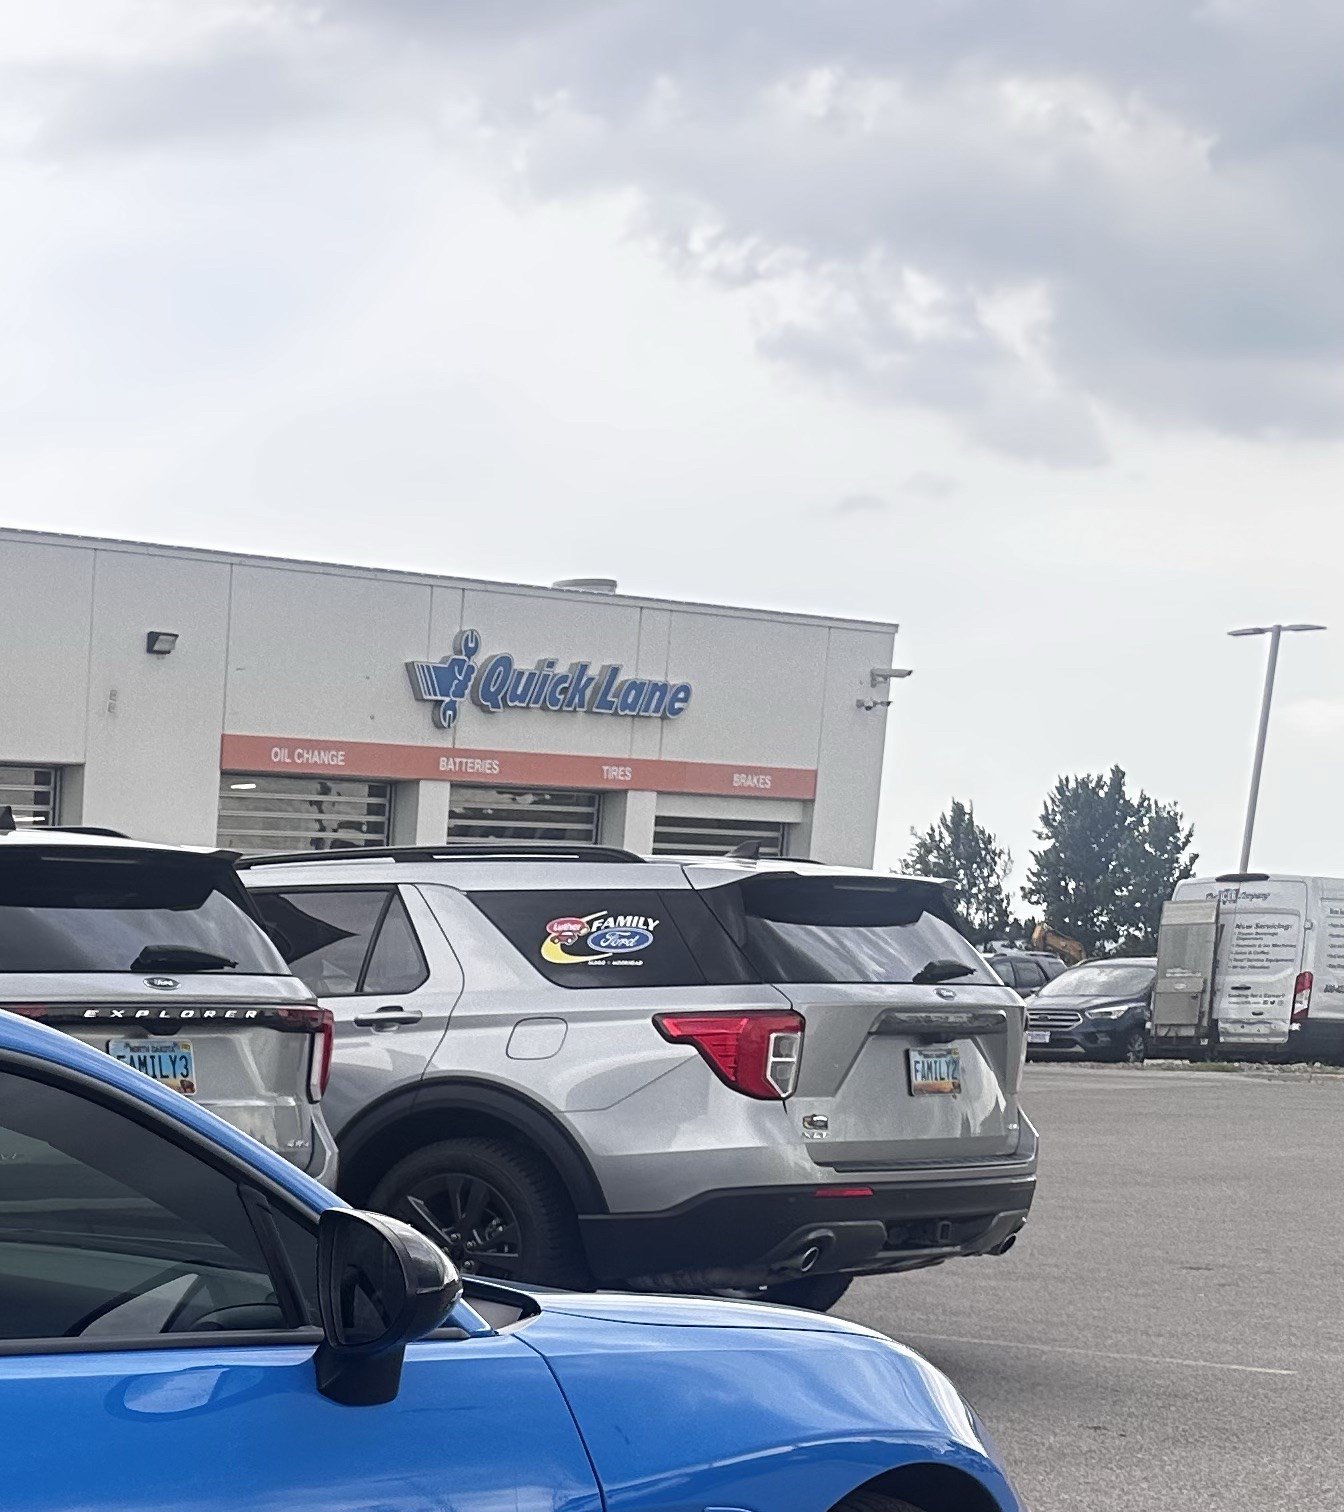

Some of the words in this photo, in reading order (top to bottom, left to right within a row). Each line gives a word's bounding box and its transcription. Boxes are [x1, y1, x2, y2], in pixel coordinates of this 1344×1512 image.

[476, 652, 596, 713] Quick
[593, 664, 692, 719] Lane
[271, 747, 290, 763] OIL
[294, 748, 346, 766] CHANGE
[439, 757, 500, 775] BATTERIES
[602, 765, 632, 781] TIRES
[733, 773, 772, 789] BRAKES
[590, 915, 660, 933] FAMILY
[599, 931, 641, 948] Ford
[83, 1009, 258, 1019] EXPLORER
[116, 1054, 190, 1079] AMILY3
[913, 1059, 959, 1081] FAMILY2
